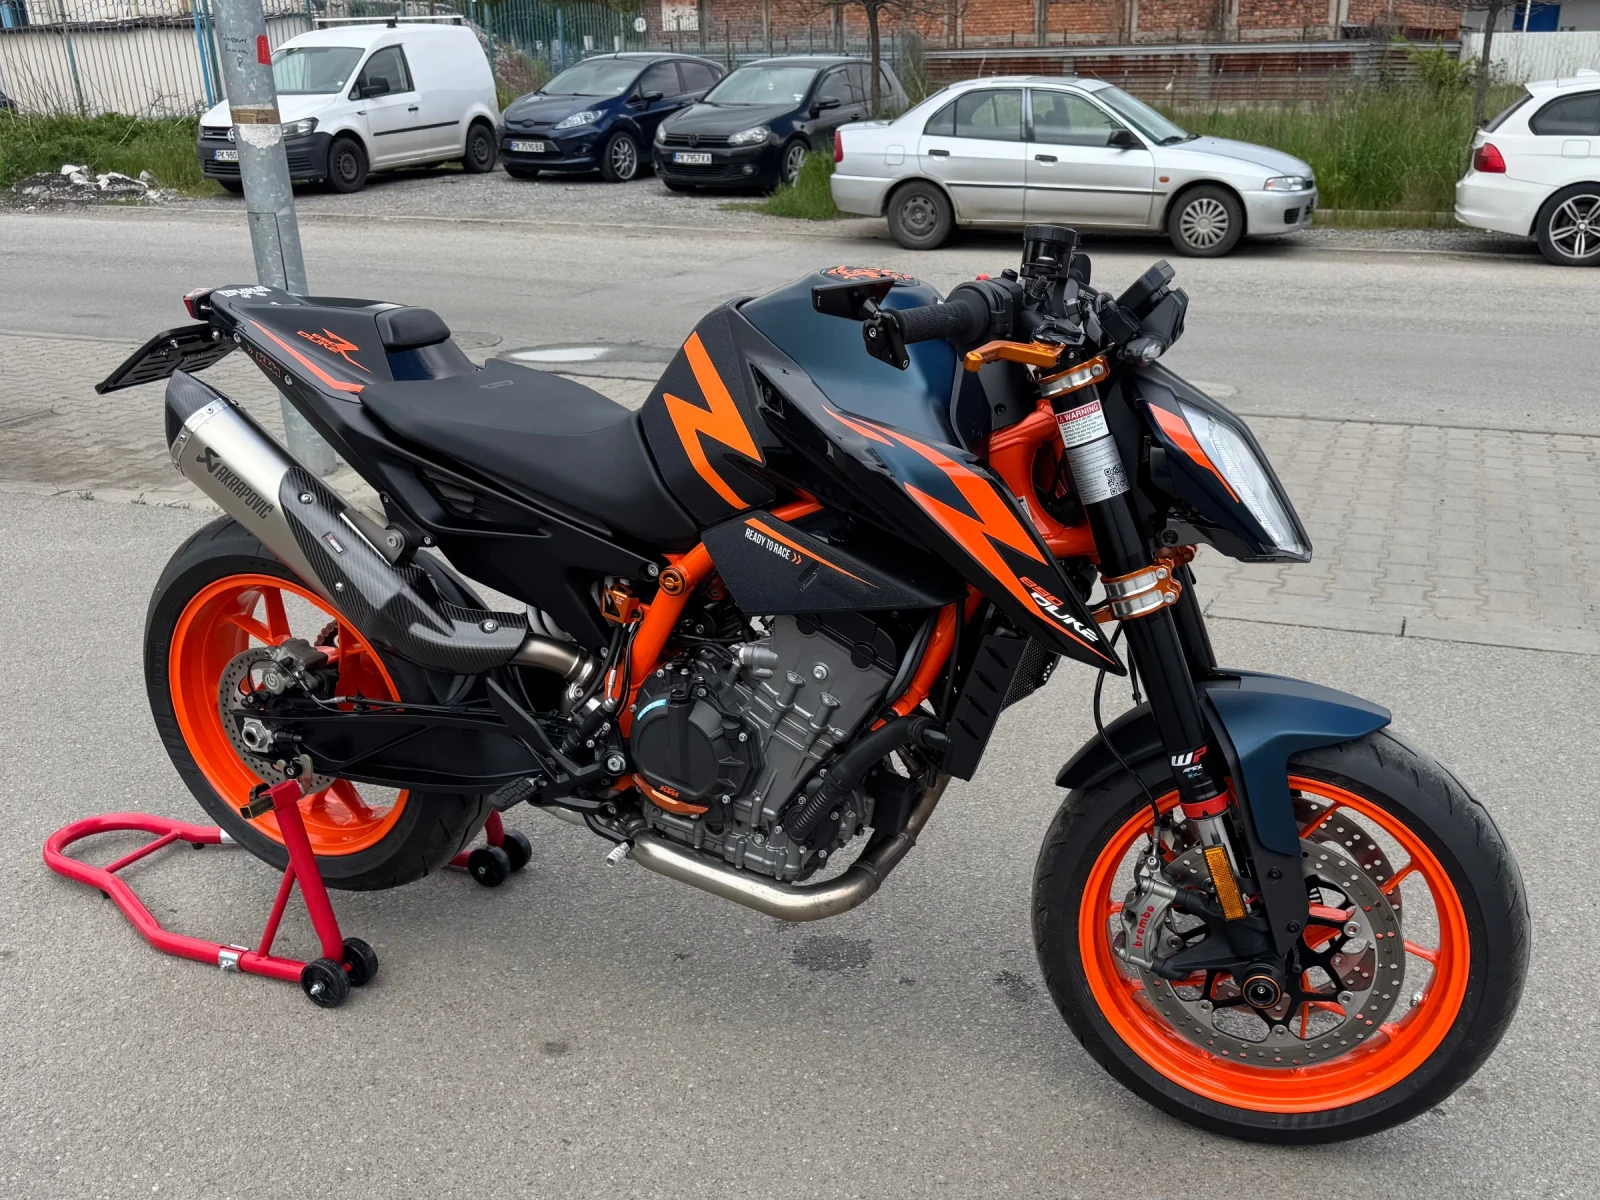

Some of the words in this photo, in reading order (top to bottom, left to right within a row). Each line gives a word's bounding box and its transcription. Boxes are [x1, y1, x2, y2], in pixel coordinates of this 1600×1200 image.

[1064, 402, 1100, 422] WARNING
[745, 528, 767, 546] READY
[766, 538, 774, 551] TO
[773, 543, 792, 560] RACE
[1019, 576, 1065, 607] 890
[1030, 592, 1099, 642] DUKE
[1171, 745, 1207, 767] WP
[659, 785, 680, 798] KTM
[1131, 905, 1155, 949] brembo
